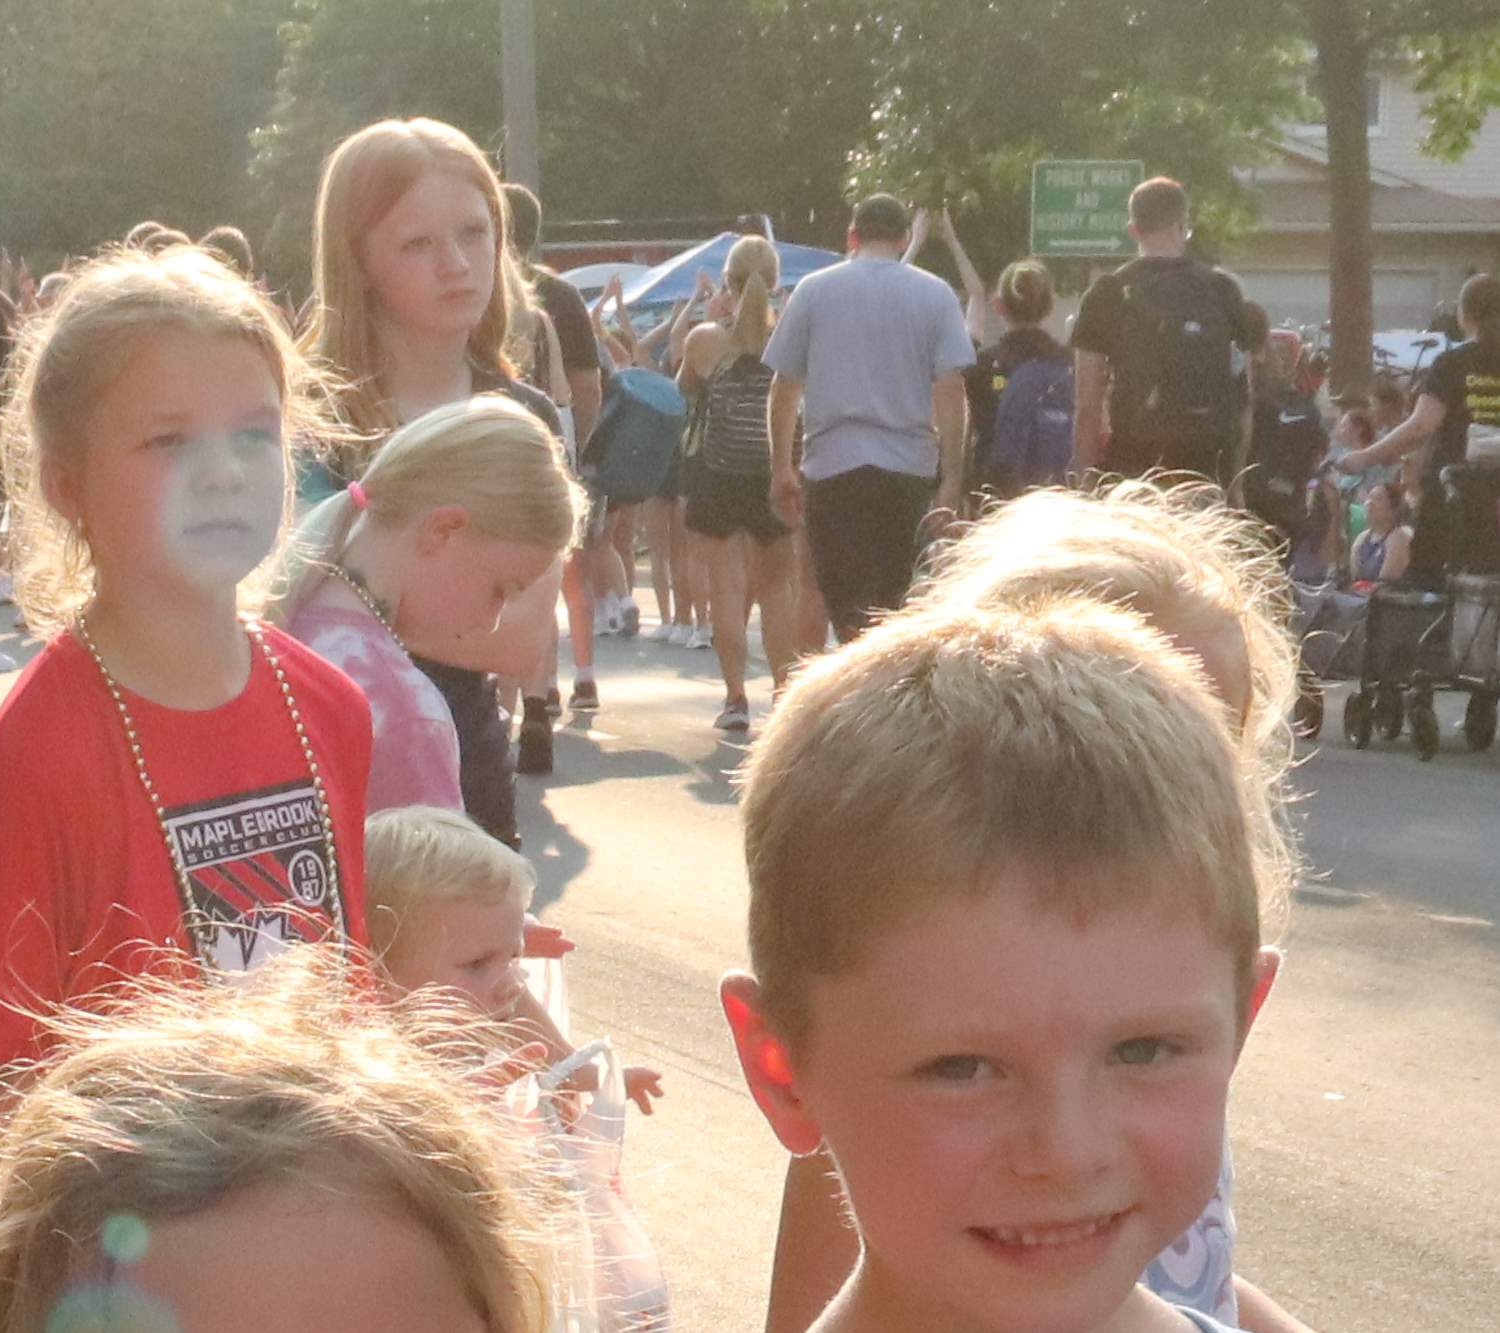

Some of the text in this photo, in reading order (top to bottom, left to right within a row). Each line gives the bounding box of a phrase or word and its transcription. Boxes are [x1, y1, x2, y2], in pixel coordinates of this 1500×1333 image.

[276, 824, 322, 843] CLUB
[298, 859, 318, 879] 19
[301, 879, 321, 899] 87
